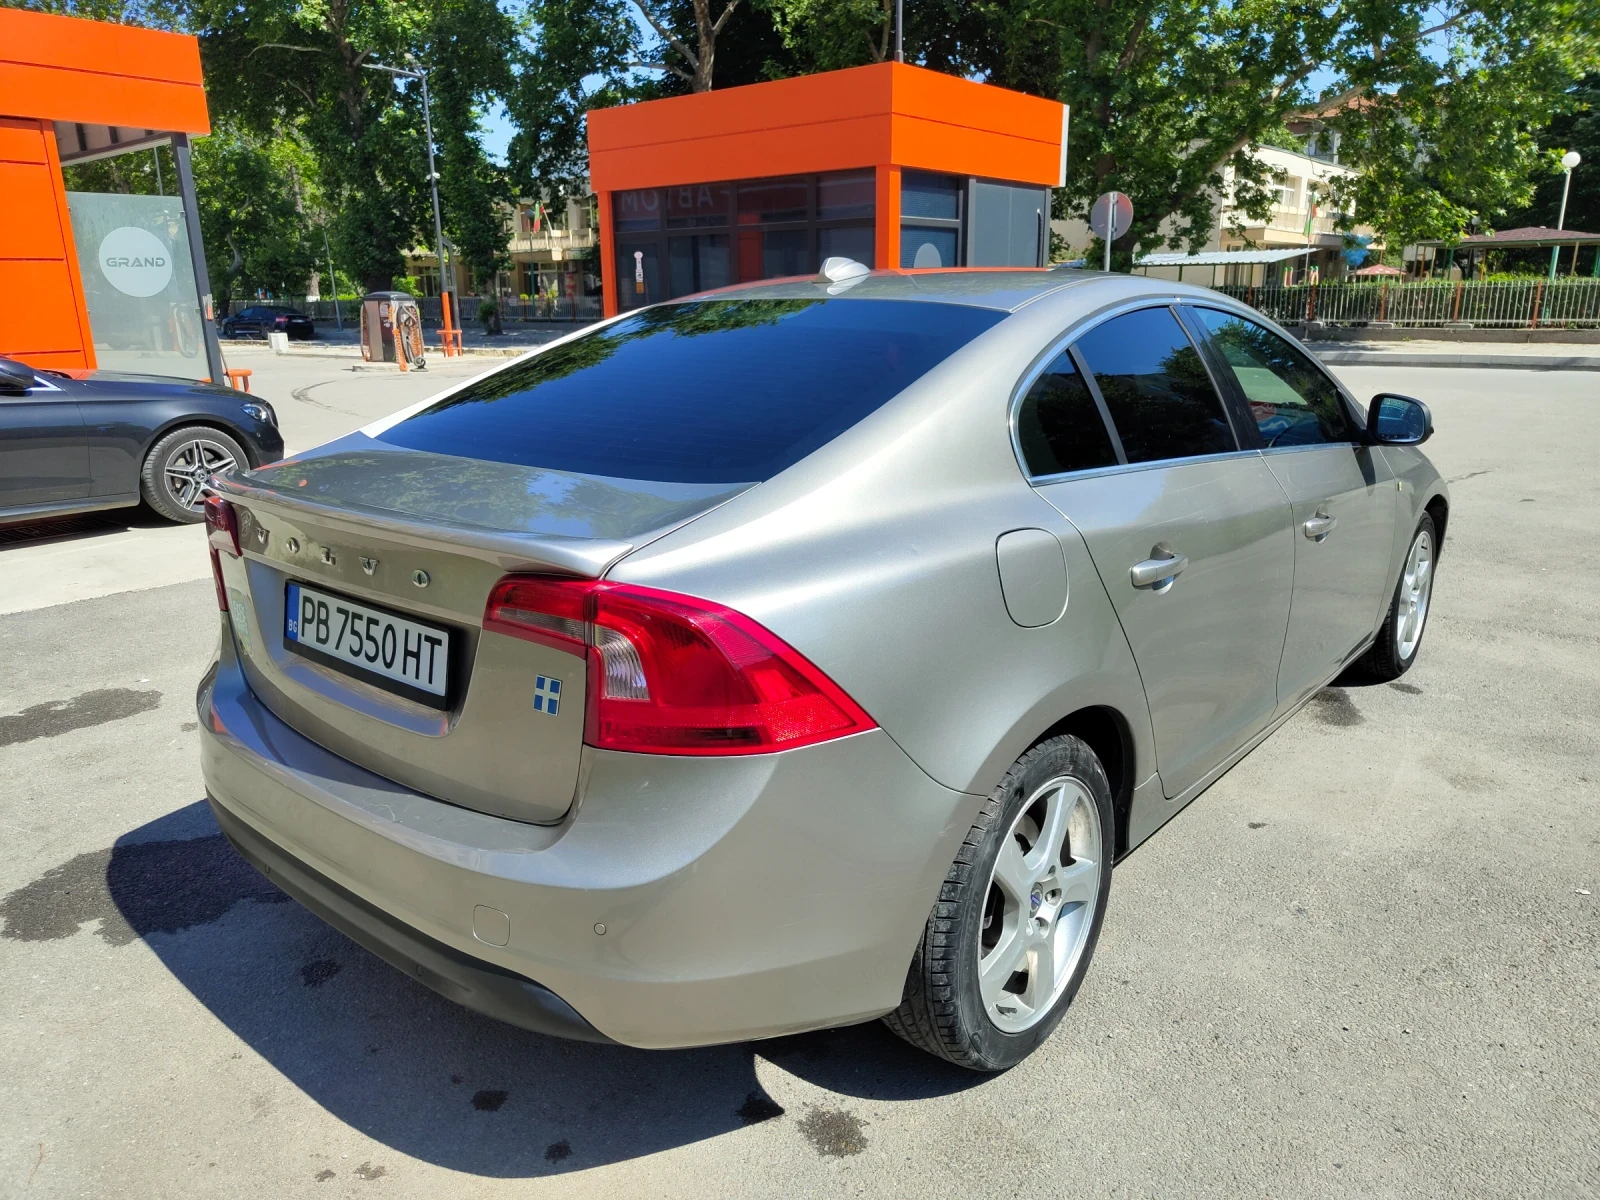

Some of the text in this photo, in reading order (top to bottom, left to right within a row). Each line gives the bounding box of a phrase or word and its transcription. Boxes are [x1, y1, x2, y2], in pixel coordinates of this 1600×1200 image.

[106, 257, 165, 267] GRAND
[256, 528, 431, 588] VOLVO
[288, 618, 298, 633] BG
[301, 595, 330, 646] PB
[335, 606, 397, 670] 7550
[402, 629, 443, 685] HT
